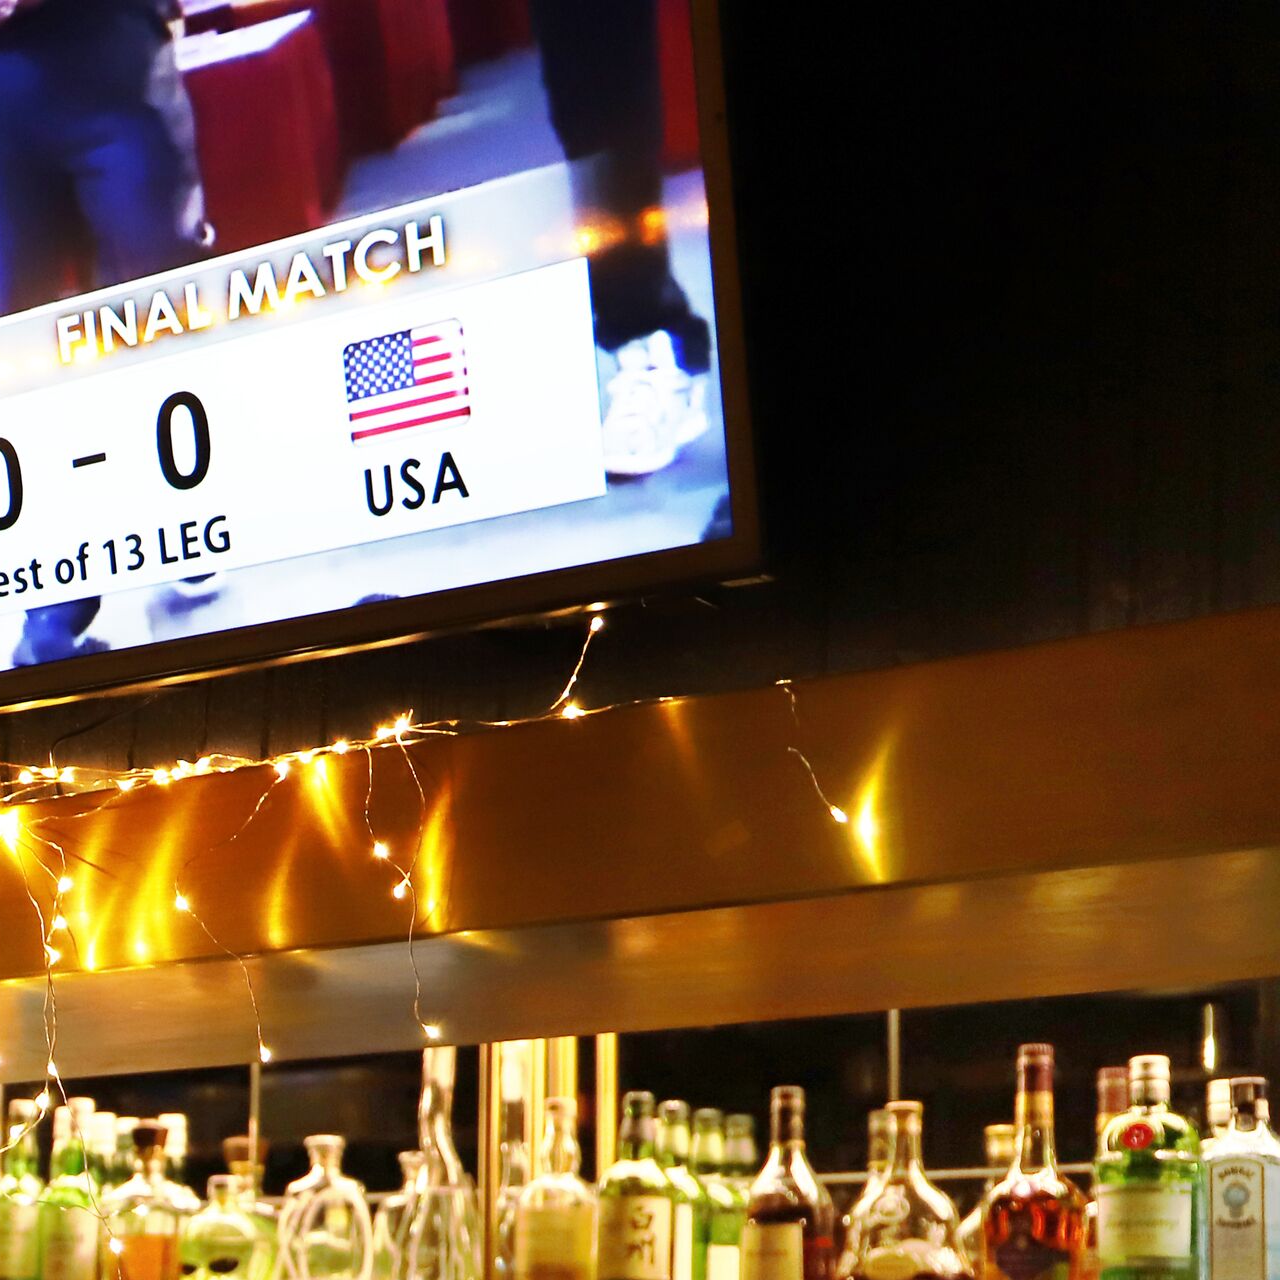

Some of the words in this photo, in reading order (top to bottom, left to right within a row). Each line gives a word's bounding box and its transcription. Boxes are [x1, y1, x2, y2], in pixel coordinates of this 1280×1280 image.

[55, 280, 214, 365] FINAL
[227, 213, 448, 322] MATCH
[71, 451, 108, 469] -
[156, 390, 212, 492] 0
[364, 451, 470, 517] USA
[54, 542, 90, 585] of
[101, 533, 146, 575] 13
[158, 514, 233, 566] LEG
